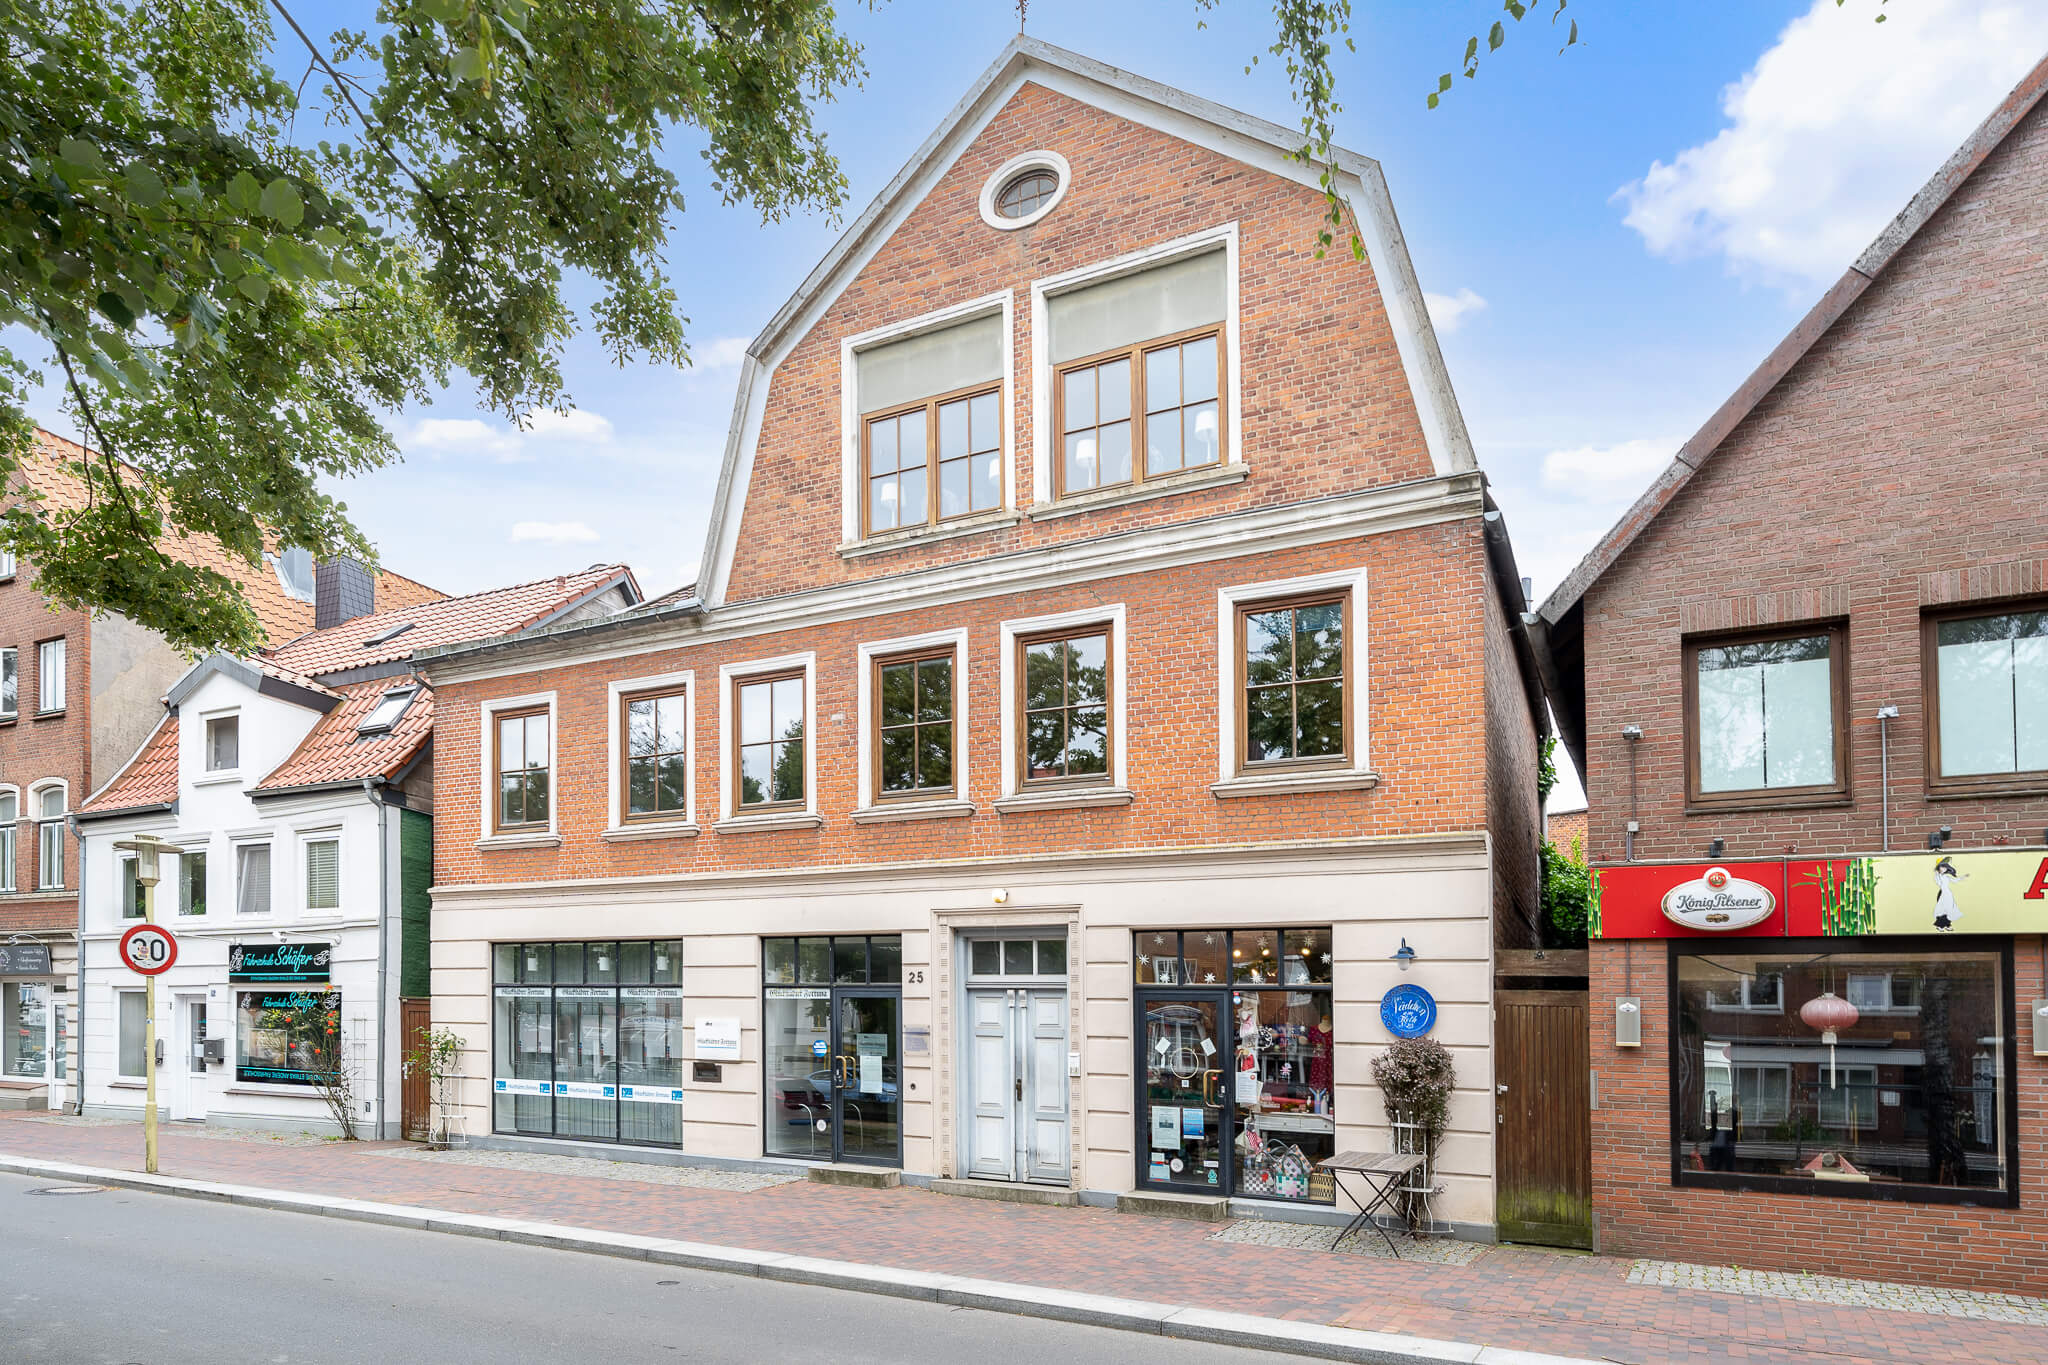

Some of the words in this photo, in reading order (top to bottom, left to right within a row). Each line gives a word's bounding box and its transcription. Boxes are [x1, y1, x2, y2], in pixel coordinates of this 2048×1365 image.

[1677, 894, 1714, 912] König
[1713, 893, 1762, 909] Pilsener
[132, 938, 165, 961] 30
[274, 945, 313, 972] Schäfer
[908, 971, 924, 984] 25
